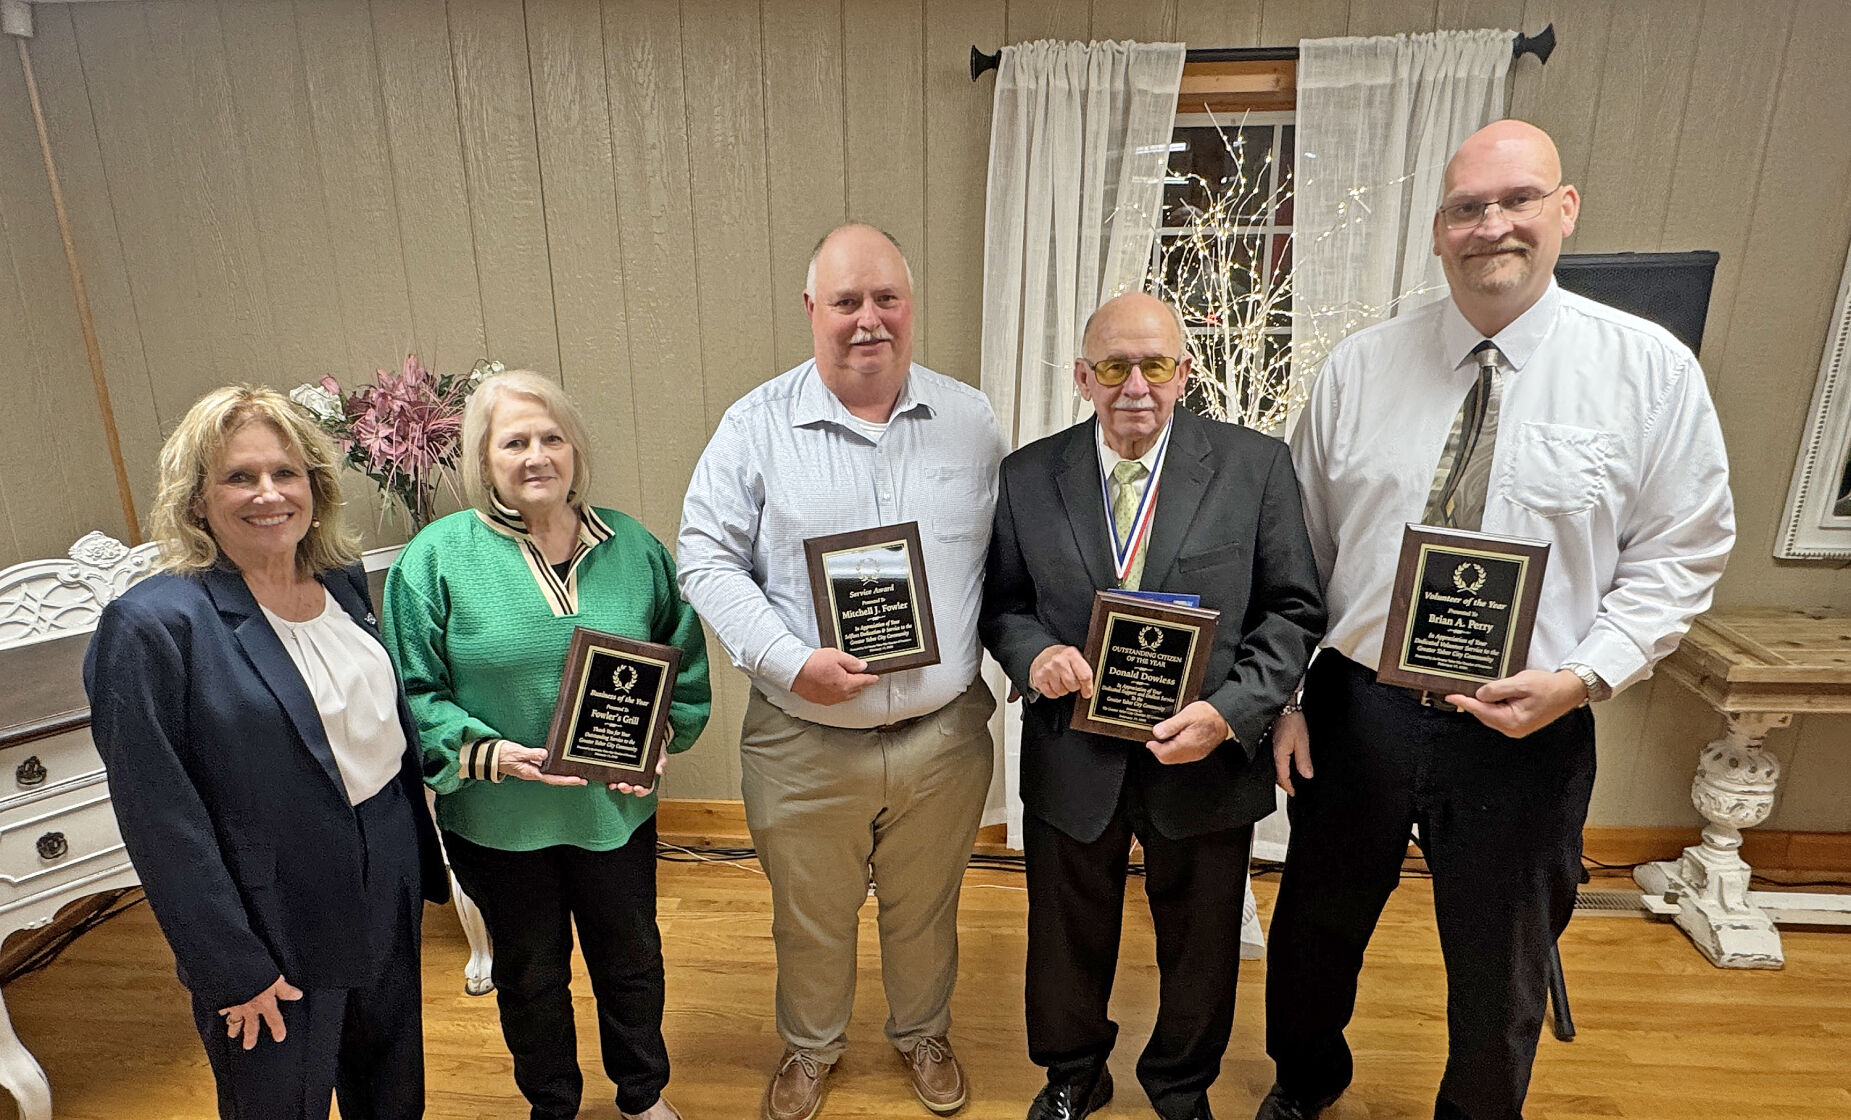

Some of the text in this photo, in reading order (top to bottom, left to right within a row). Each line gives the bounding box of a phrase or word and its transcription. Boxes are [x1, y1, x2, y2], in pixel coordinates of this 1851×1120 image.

[849, 584, 894, 598] Service Award
[1425, 592, 1507, 610] Volunteer of the Year
[842, 602, 908, 619] Mitchell J. Fowler
[1429, 614, 1494, 634] Brian A. Perry
[1112, 645, 1182, 663] OUTSTANDING CITIZEN
[1452, 651, 1464, 659] City
[1150, 660, 1166, 668] YEAR
[1109, 667, 1175, 686] Donald Dowless
[590, 689, 616, 700] Business
[617, 695, 626, 703] of
[636, 698, 649, 706] Year
[591, 709, 639, 725] Fowler's Grill
